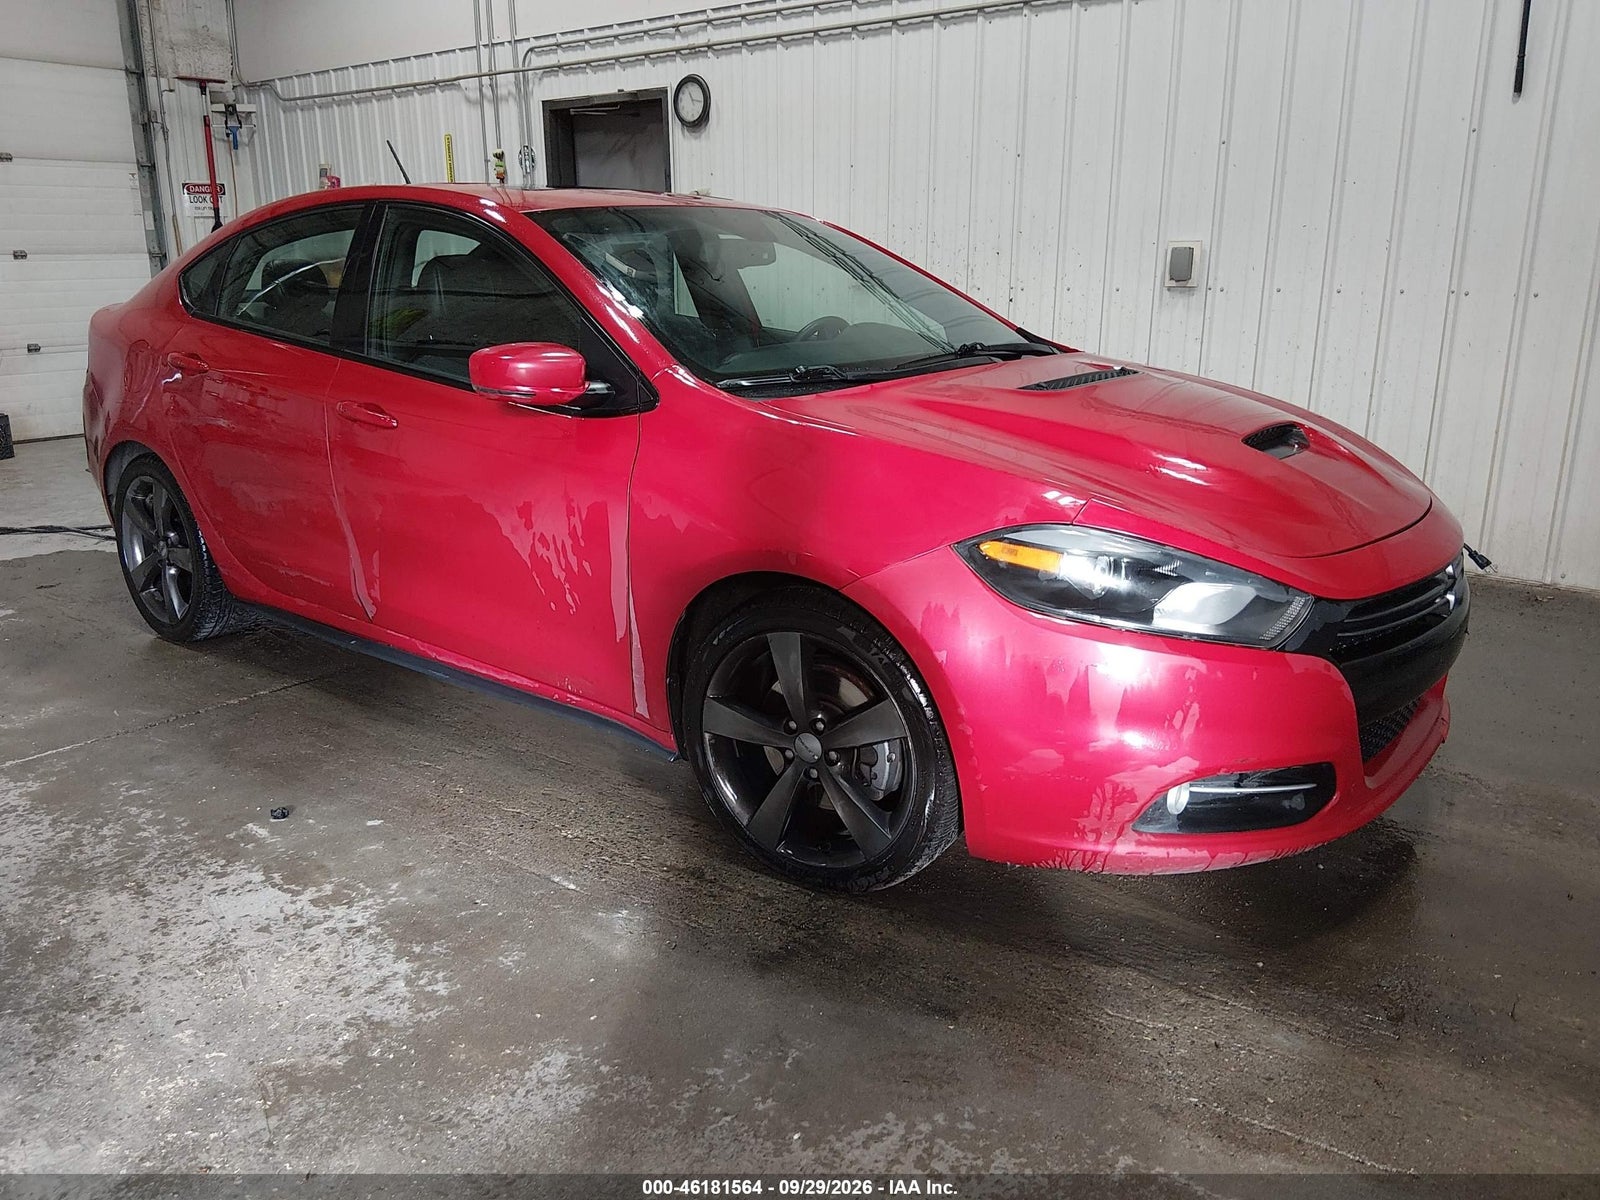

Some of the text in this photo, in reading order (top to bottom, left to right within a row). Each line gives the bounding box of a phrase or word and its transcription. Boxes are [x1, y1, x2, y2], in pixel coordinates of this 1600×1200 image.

[189, 185, 220, 193] DANGR
[189, 195, 223, 204] LOOK OT
